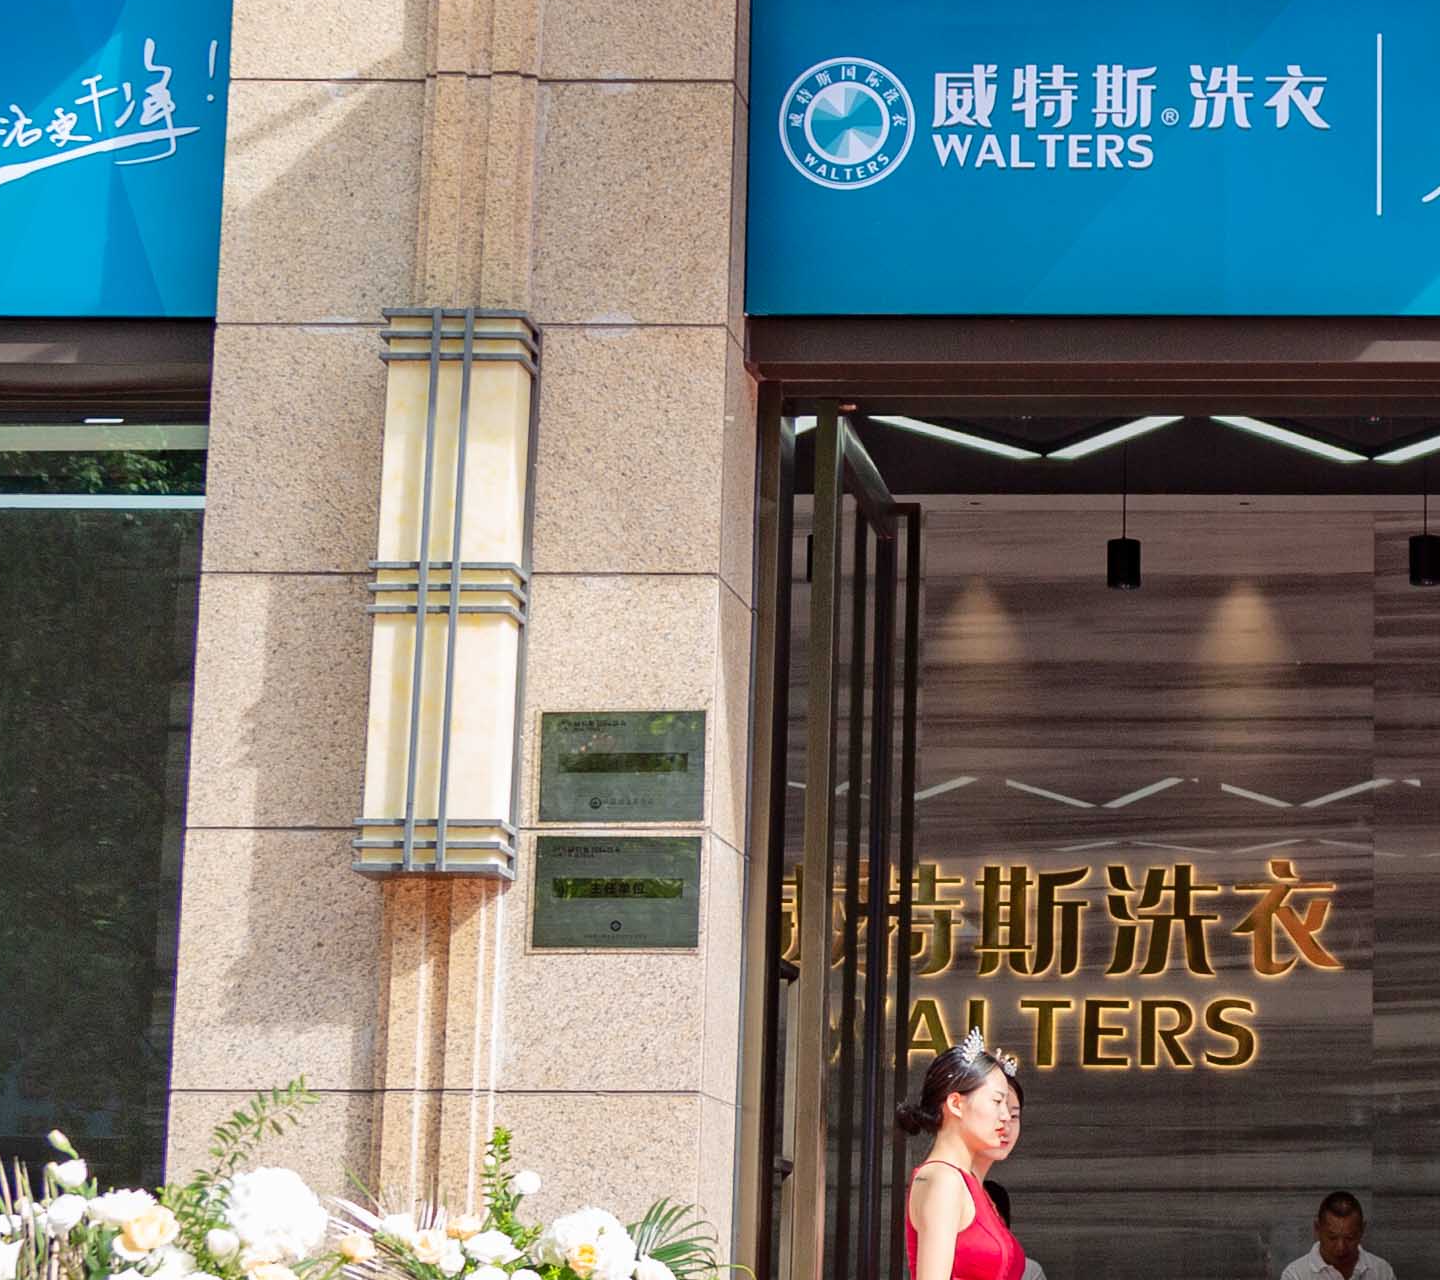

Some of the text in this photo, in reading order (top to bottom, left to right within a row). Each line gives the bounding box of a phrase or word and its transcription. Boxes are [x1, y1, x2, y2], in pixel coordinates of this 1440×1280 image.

[802, 151, 891, 181] WALTERS
[933, 134, 1155, 169] WALTERS
[826, 997, 1258, 1070] ATERS
